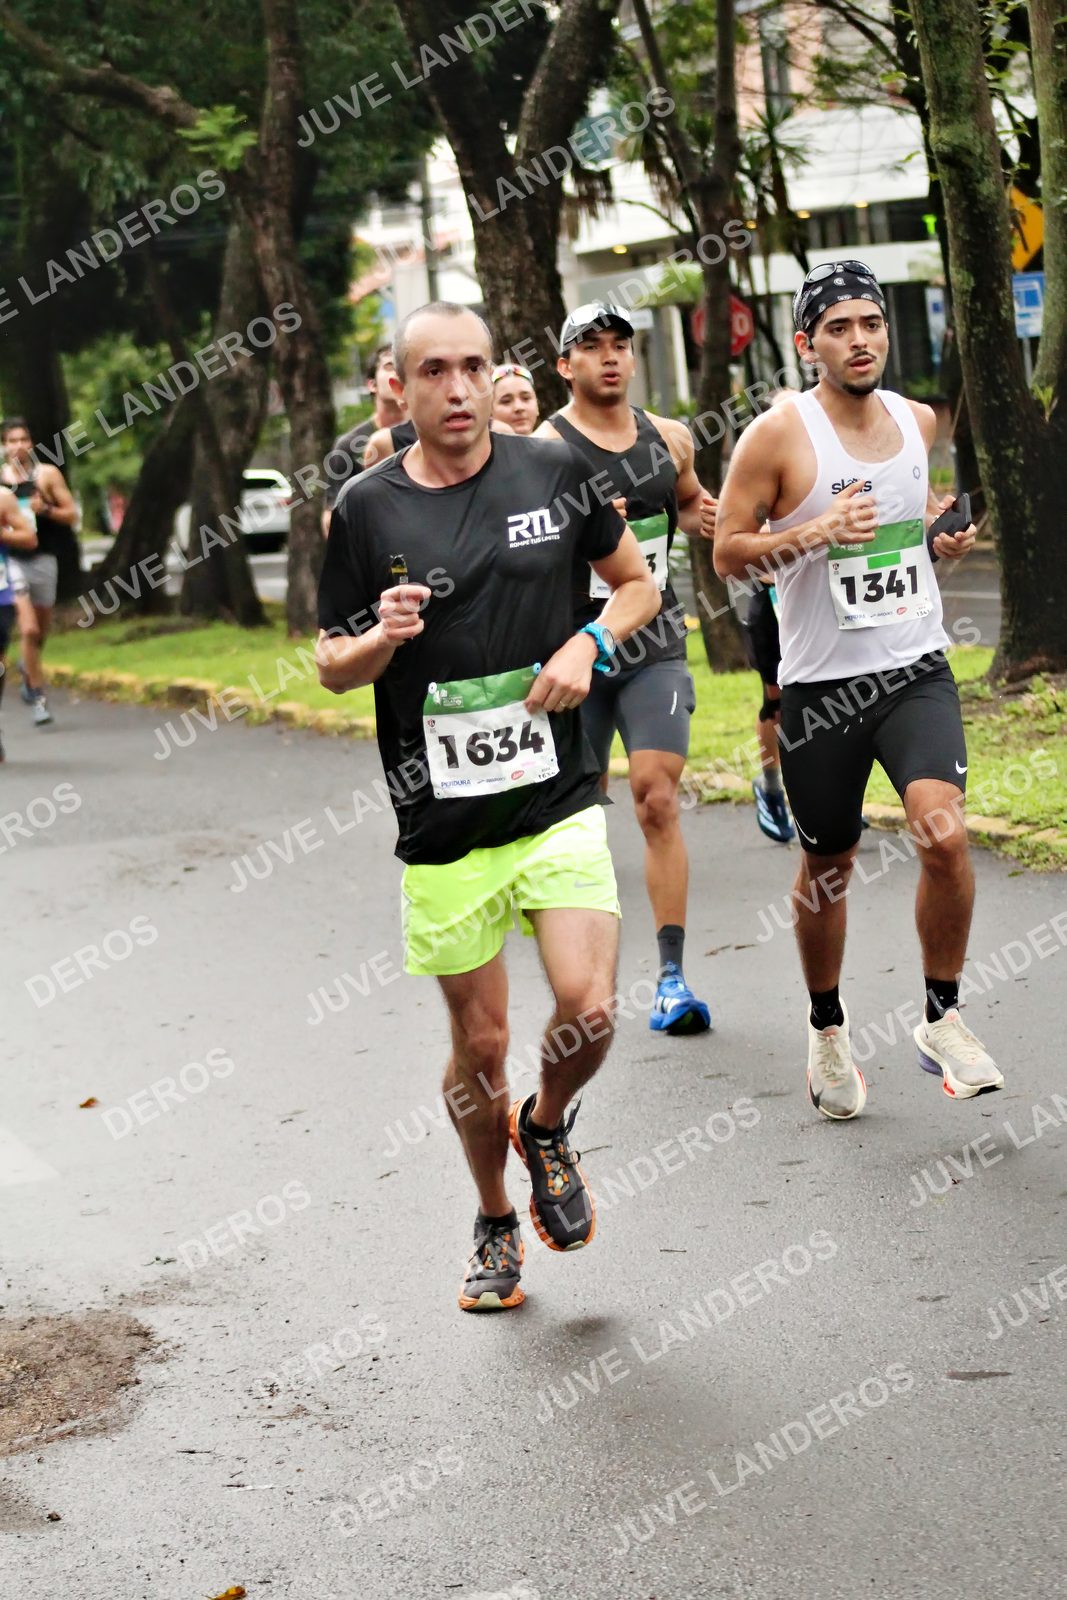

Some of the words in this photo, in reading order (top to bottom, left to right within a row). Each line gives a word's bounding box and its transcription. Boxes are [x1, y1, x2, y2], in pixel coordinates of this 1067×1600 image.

[507, 509, 560, 542] RTL
[509, 539, 529, 548] ROMPE
[530, 537, 541, 545] TUS
[541, 534, 560, 542] LIMITES
[840, 565, 918, 605] 1341
[438, 720, 545, 769] 1634
